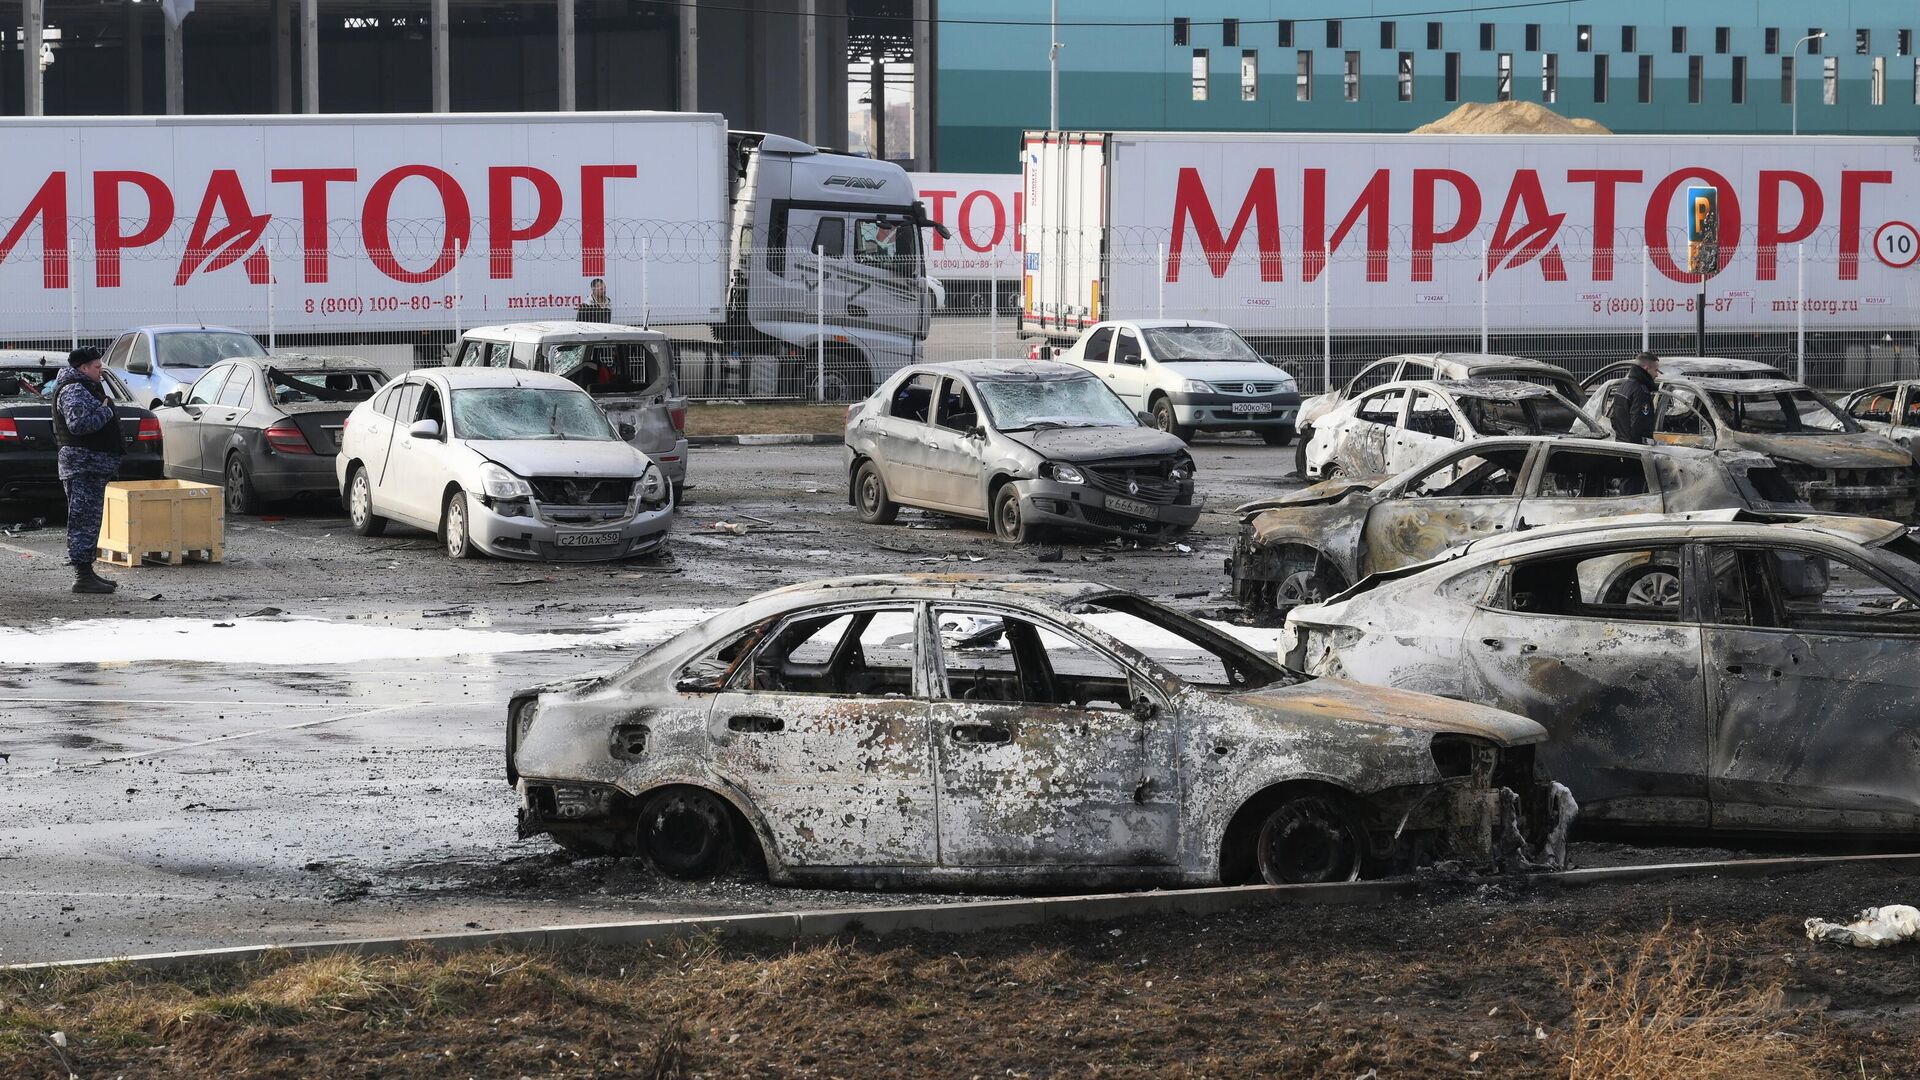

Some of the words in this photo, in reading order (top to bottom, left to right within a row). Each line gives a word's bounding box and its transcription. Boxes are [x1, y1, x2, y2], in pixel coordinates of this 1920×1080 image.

[823, 174, 888, 190] FAW
[918, 189, 1023, 253] ТО
[1165, 166, 1893, 284] МИРАТОРГ
[1886, 234, 1911, 254] 10
[304, 299, 315, 314] 8
[320, 298, 364, 317] (800)
[1592, 297, 1602, 313] 8
[1606, 297, 1645, 316] (800)
